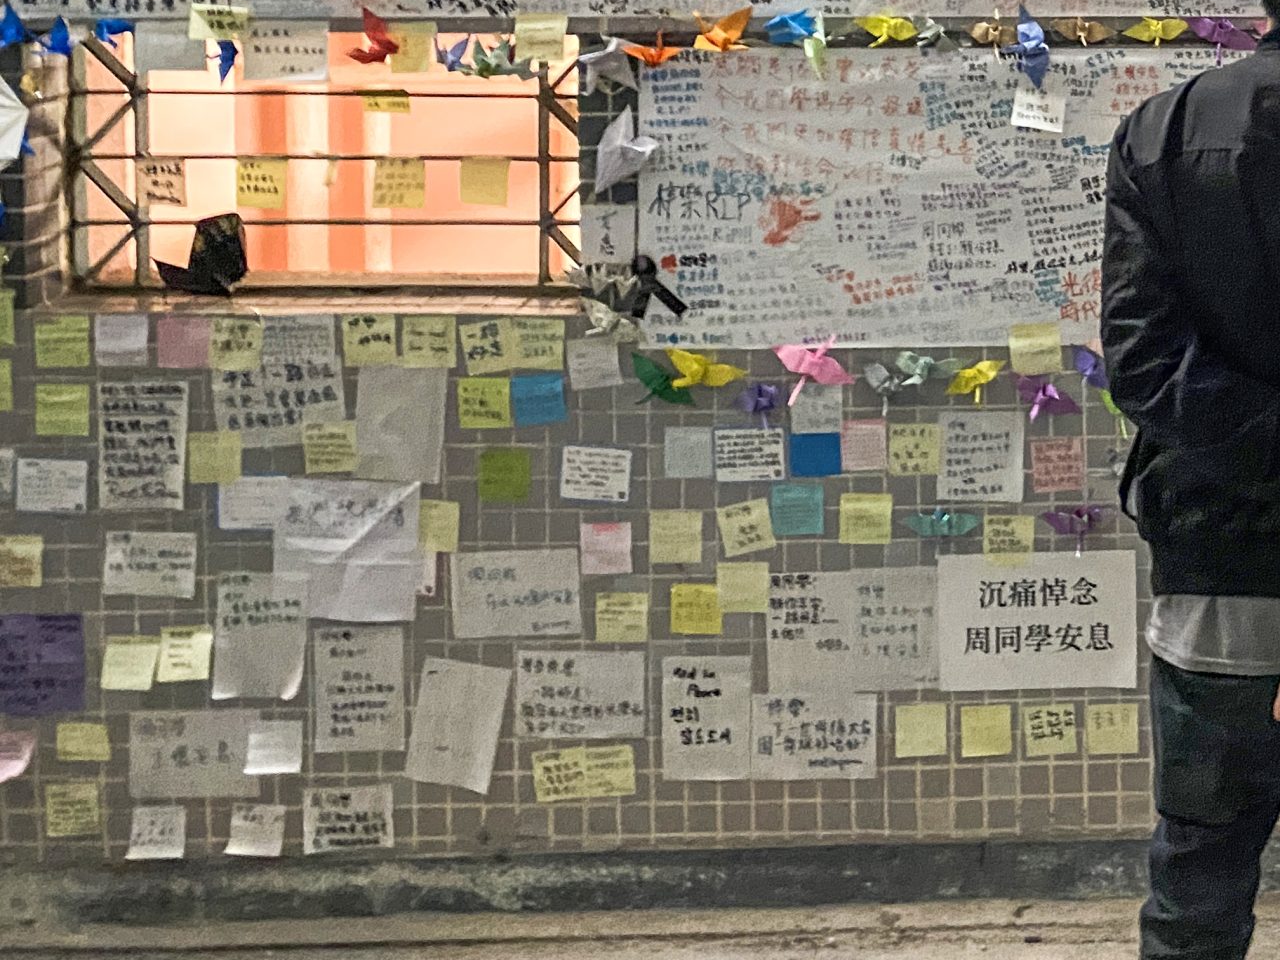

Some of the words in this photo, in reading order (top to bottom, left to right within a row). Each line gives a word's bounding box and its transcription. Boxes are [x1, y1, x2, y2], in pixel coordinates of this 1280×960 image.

[979, 578, 1099, 610] 沉痛悼念
[965, 623, 1116, 655] 周同學安息
